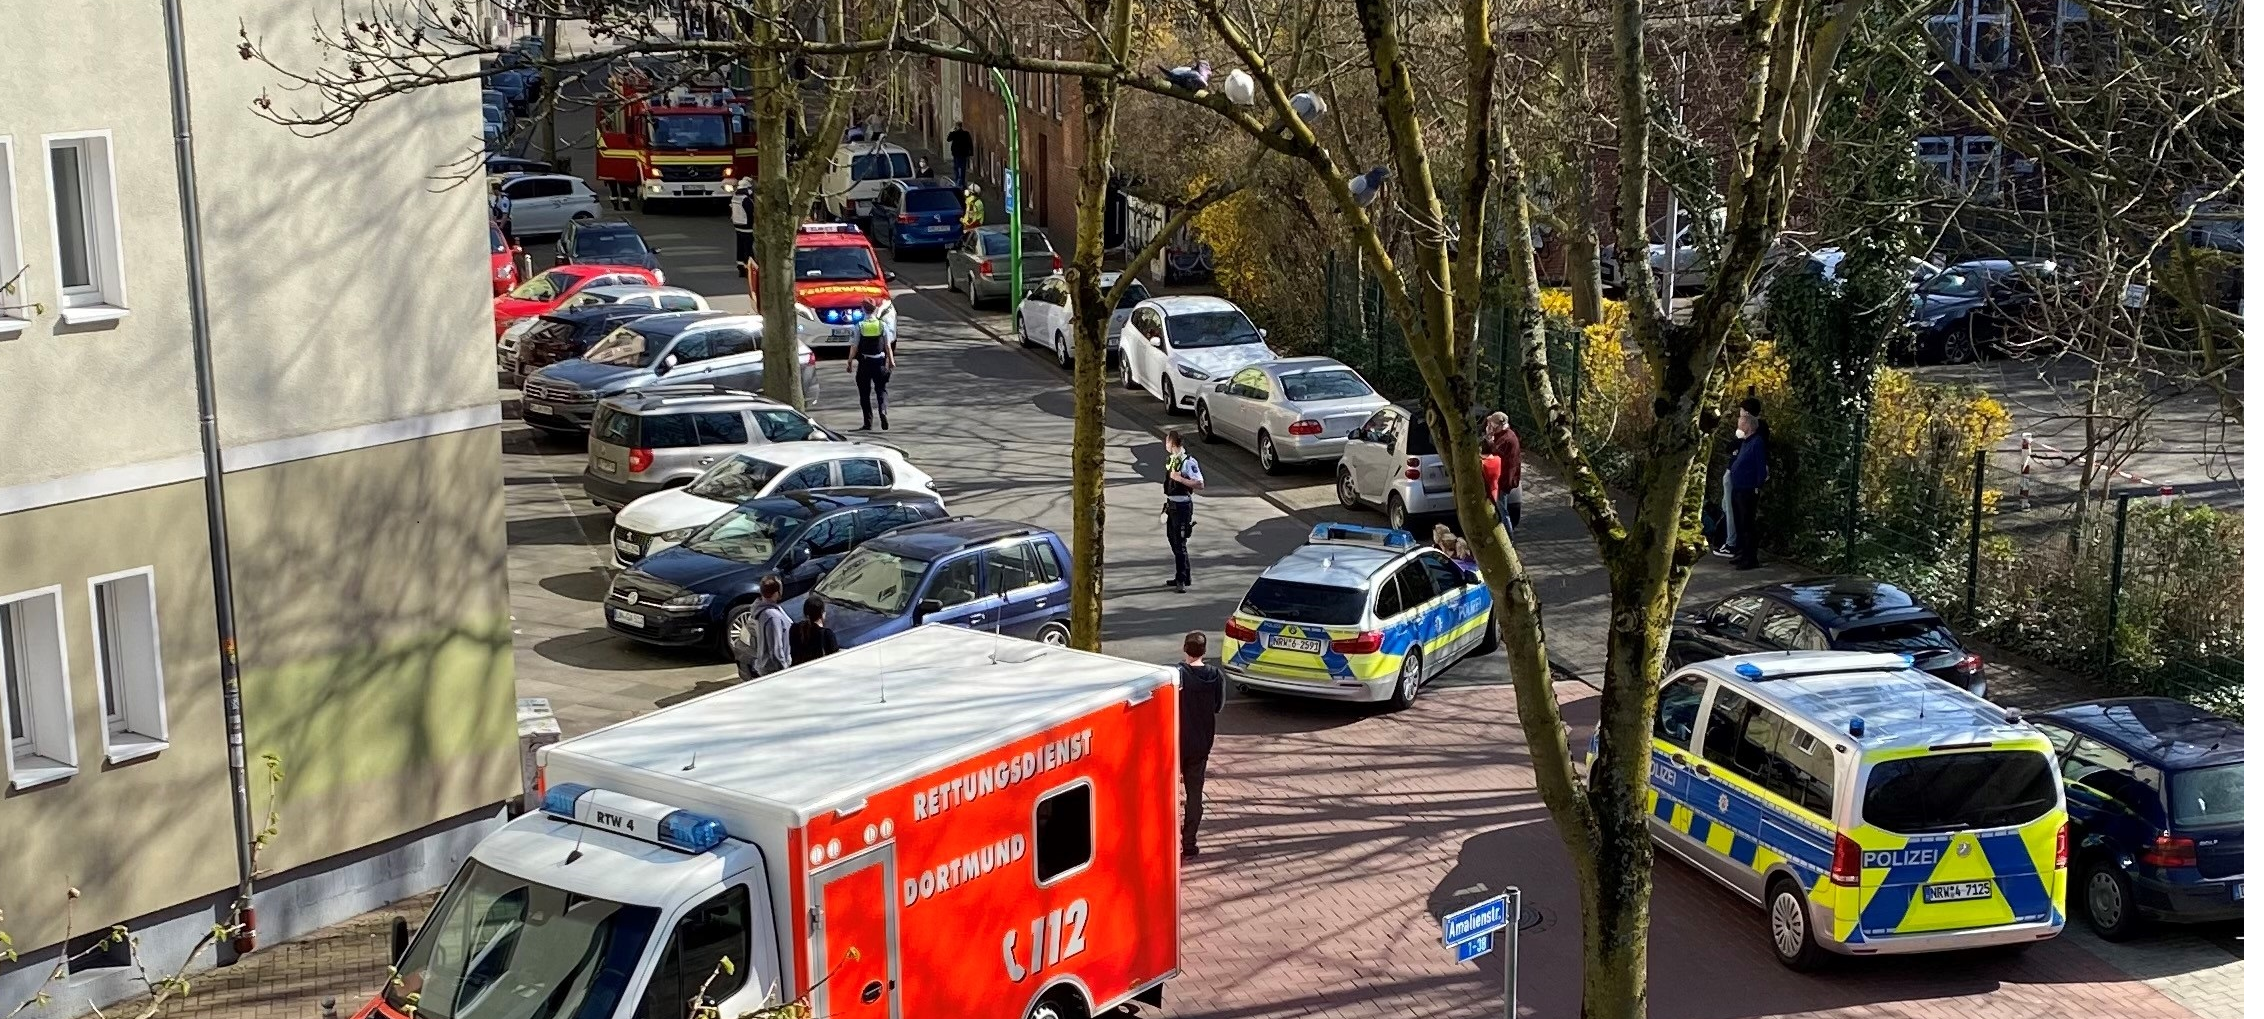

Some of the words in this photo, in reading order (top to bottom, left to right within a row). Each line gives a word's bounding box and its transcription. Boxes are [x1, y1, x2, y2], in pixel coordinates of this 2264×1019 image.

[800, 285, 882, 297] FEUERWEHR
[913, 728, 1093, 822] RETTUNGSDIENST
[1651, 760, 1677, 787] OLIZEI
[597, 811, 622, 828] RTW
[626, 819, 634, 831] 4
[903, 833, 1027, 908] DORTMUND
[1863, 849, 1939, 867] POLIZEI
[1930, 885, 1952, 899] NRW
[1448, 906, 1502, 939] Amalienstr.
[1030, 898, 1090, 976] 112
